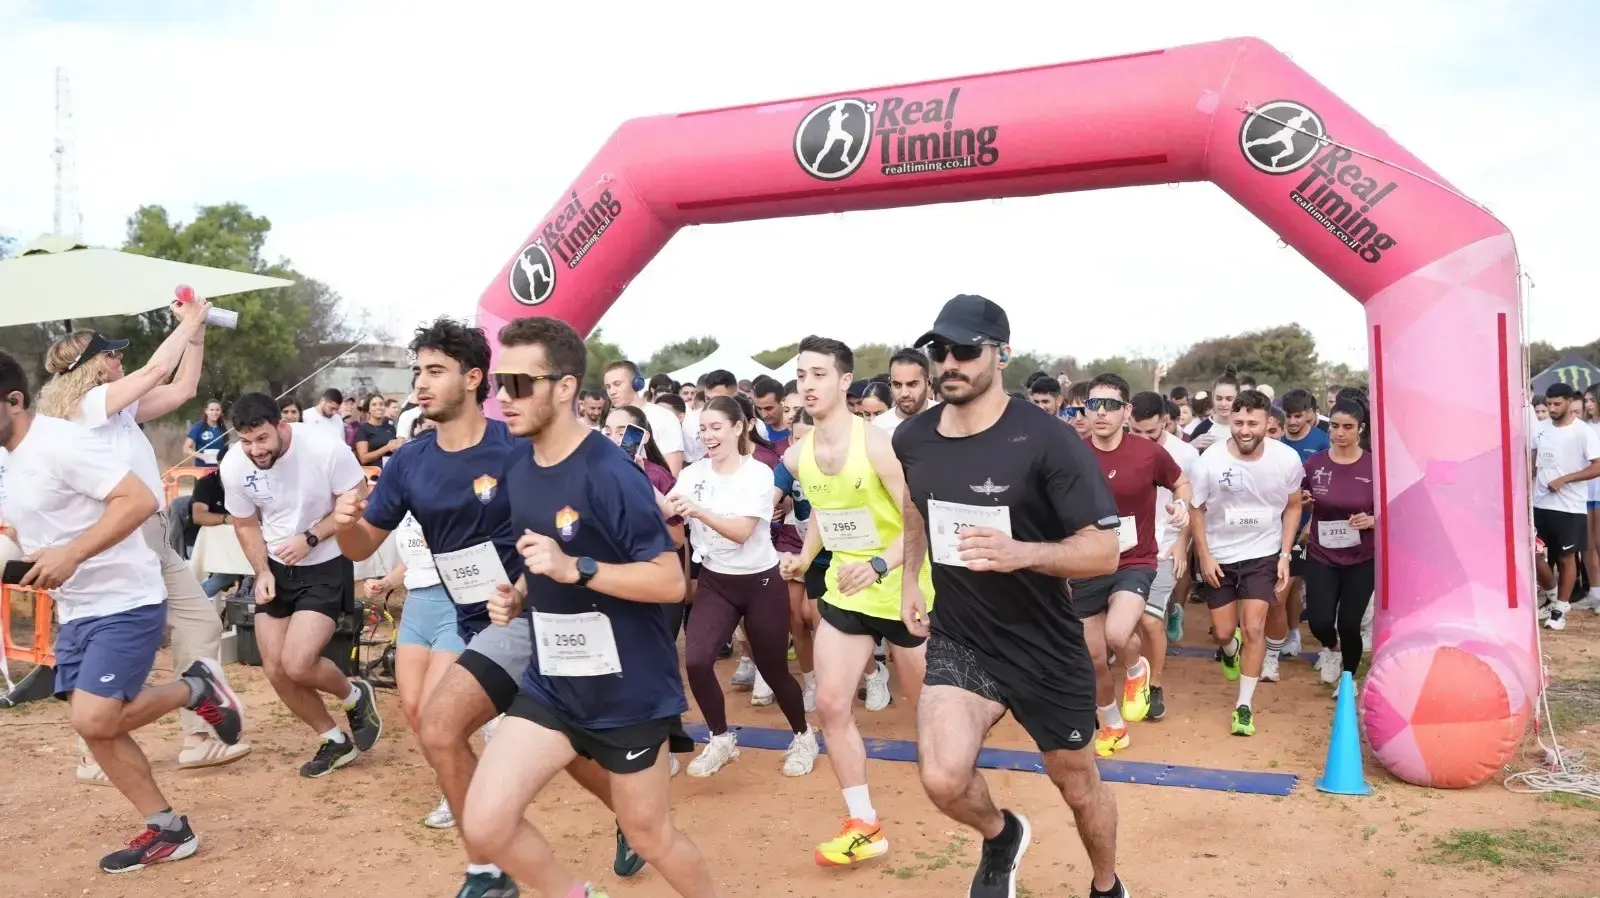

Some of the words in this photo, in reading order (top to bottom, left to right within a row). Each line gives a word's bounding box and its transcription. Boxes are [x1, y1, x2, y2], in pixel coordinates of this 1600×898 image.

[876, 87, 961, 128] Real
[875, 119, 1000, 167] Timing
[885, 156, 972, 175] realtiming.co.il
[1316, 144, 1399, 209] Real
[541, 188, 585, 251] Real
[550, 188, 622, 263] Timing
[1291, 191, 1360, 250] realtiming.co.il
[1295, 163, 1398, 264] Timing
[569, 216, 611, 268] realtiming.co.il
[832, 521, 857, 532] 2965
[1239, 517, 1259, 525] 2886
[453, 564, 480, 579] 2966
[554, 633, 587, 647] 2960
